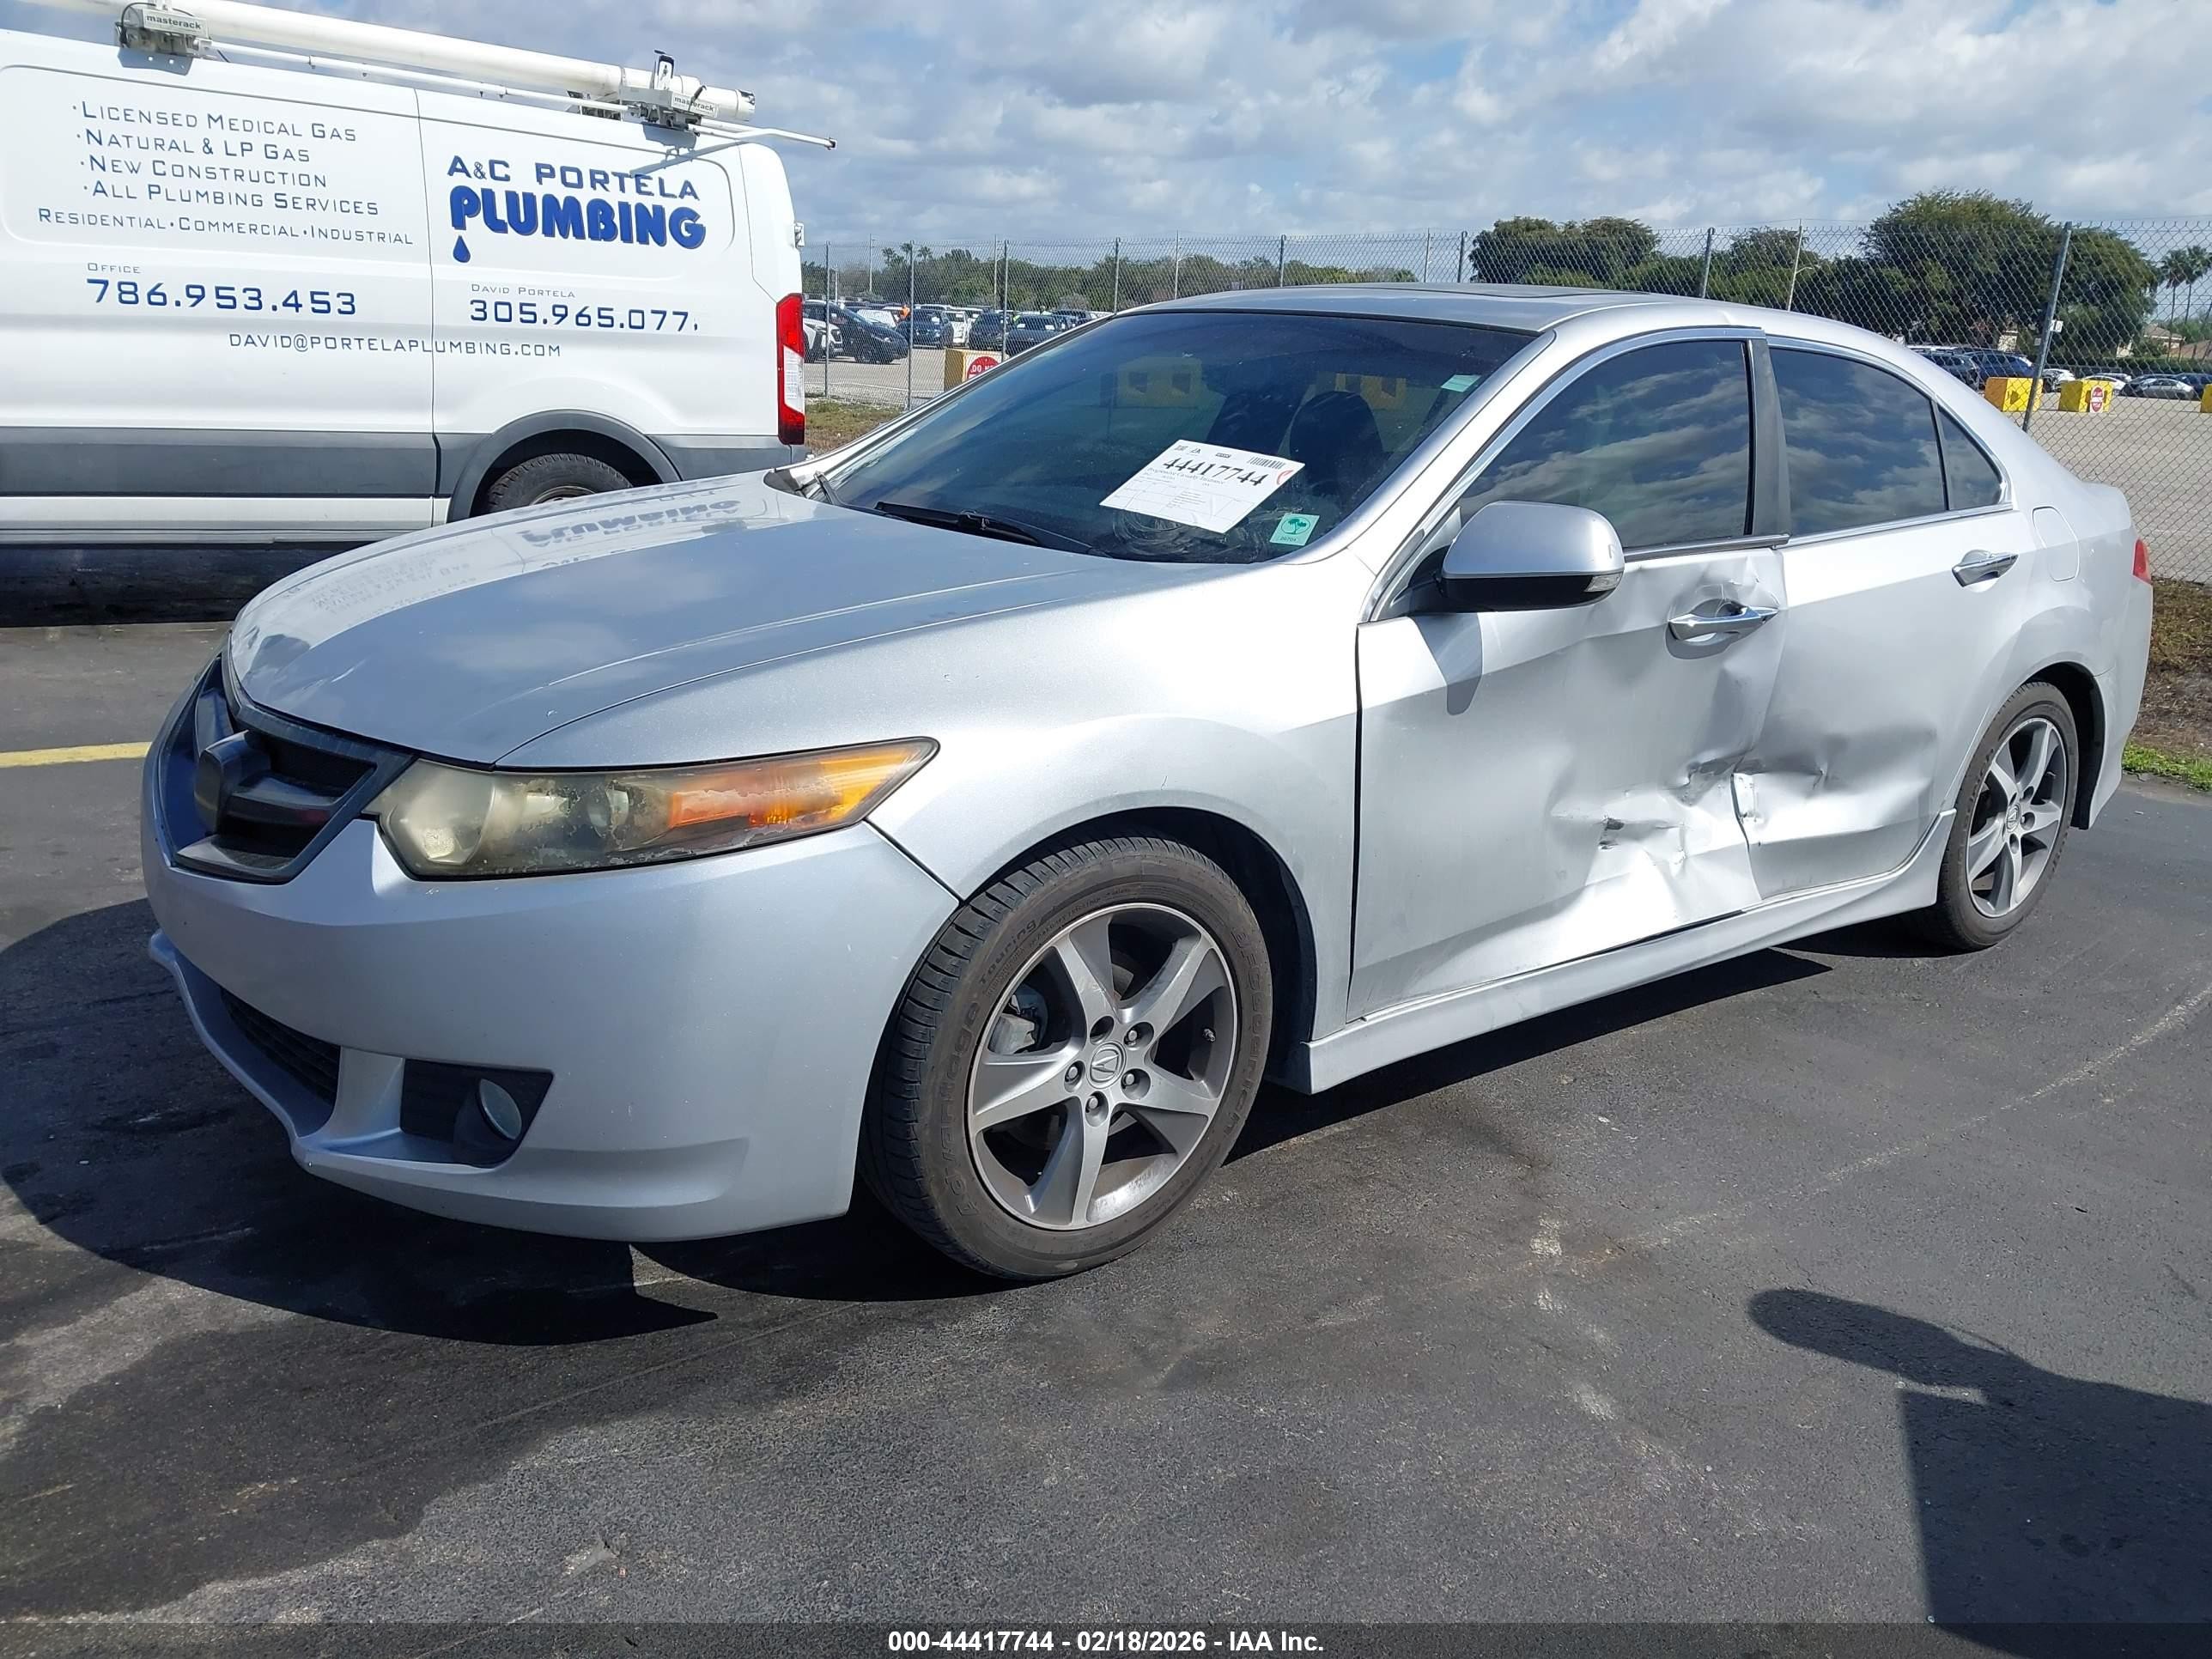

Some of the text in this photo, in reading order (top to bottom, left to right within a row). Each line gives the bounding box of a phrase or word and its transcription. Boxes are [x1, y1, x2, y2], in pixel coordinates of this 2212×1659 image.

[146, 15, 201, 29] masterack
[674, 97, 714, 112] maerack
[82, 101, 356, 142] LICENSED MEDICAL GAS
[86, 128, 310, 161] NATURAL & LP GAS
[89, 155, 326, 187] NEW CONSTRUCTION
[535, 162, 700, 200] PORTELA
[93, 180, 379, 215] ALL PLUMBING SERVICES
[450, 185, 706, 249] PLUMBING
[88, 263, 142, 274] OFFICE
[87, 278, 356, 315] 786.953.453
[471, 283, 575, 298] DAVID PORTELA
[229, 333, 561, 356] DAVID@PORTELAPLUMBING.COM
[1163, 458, 1269, 486] 44417744
